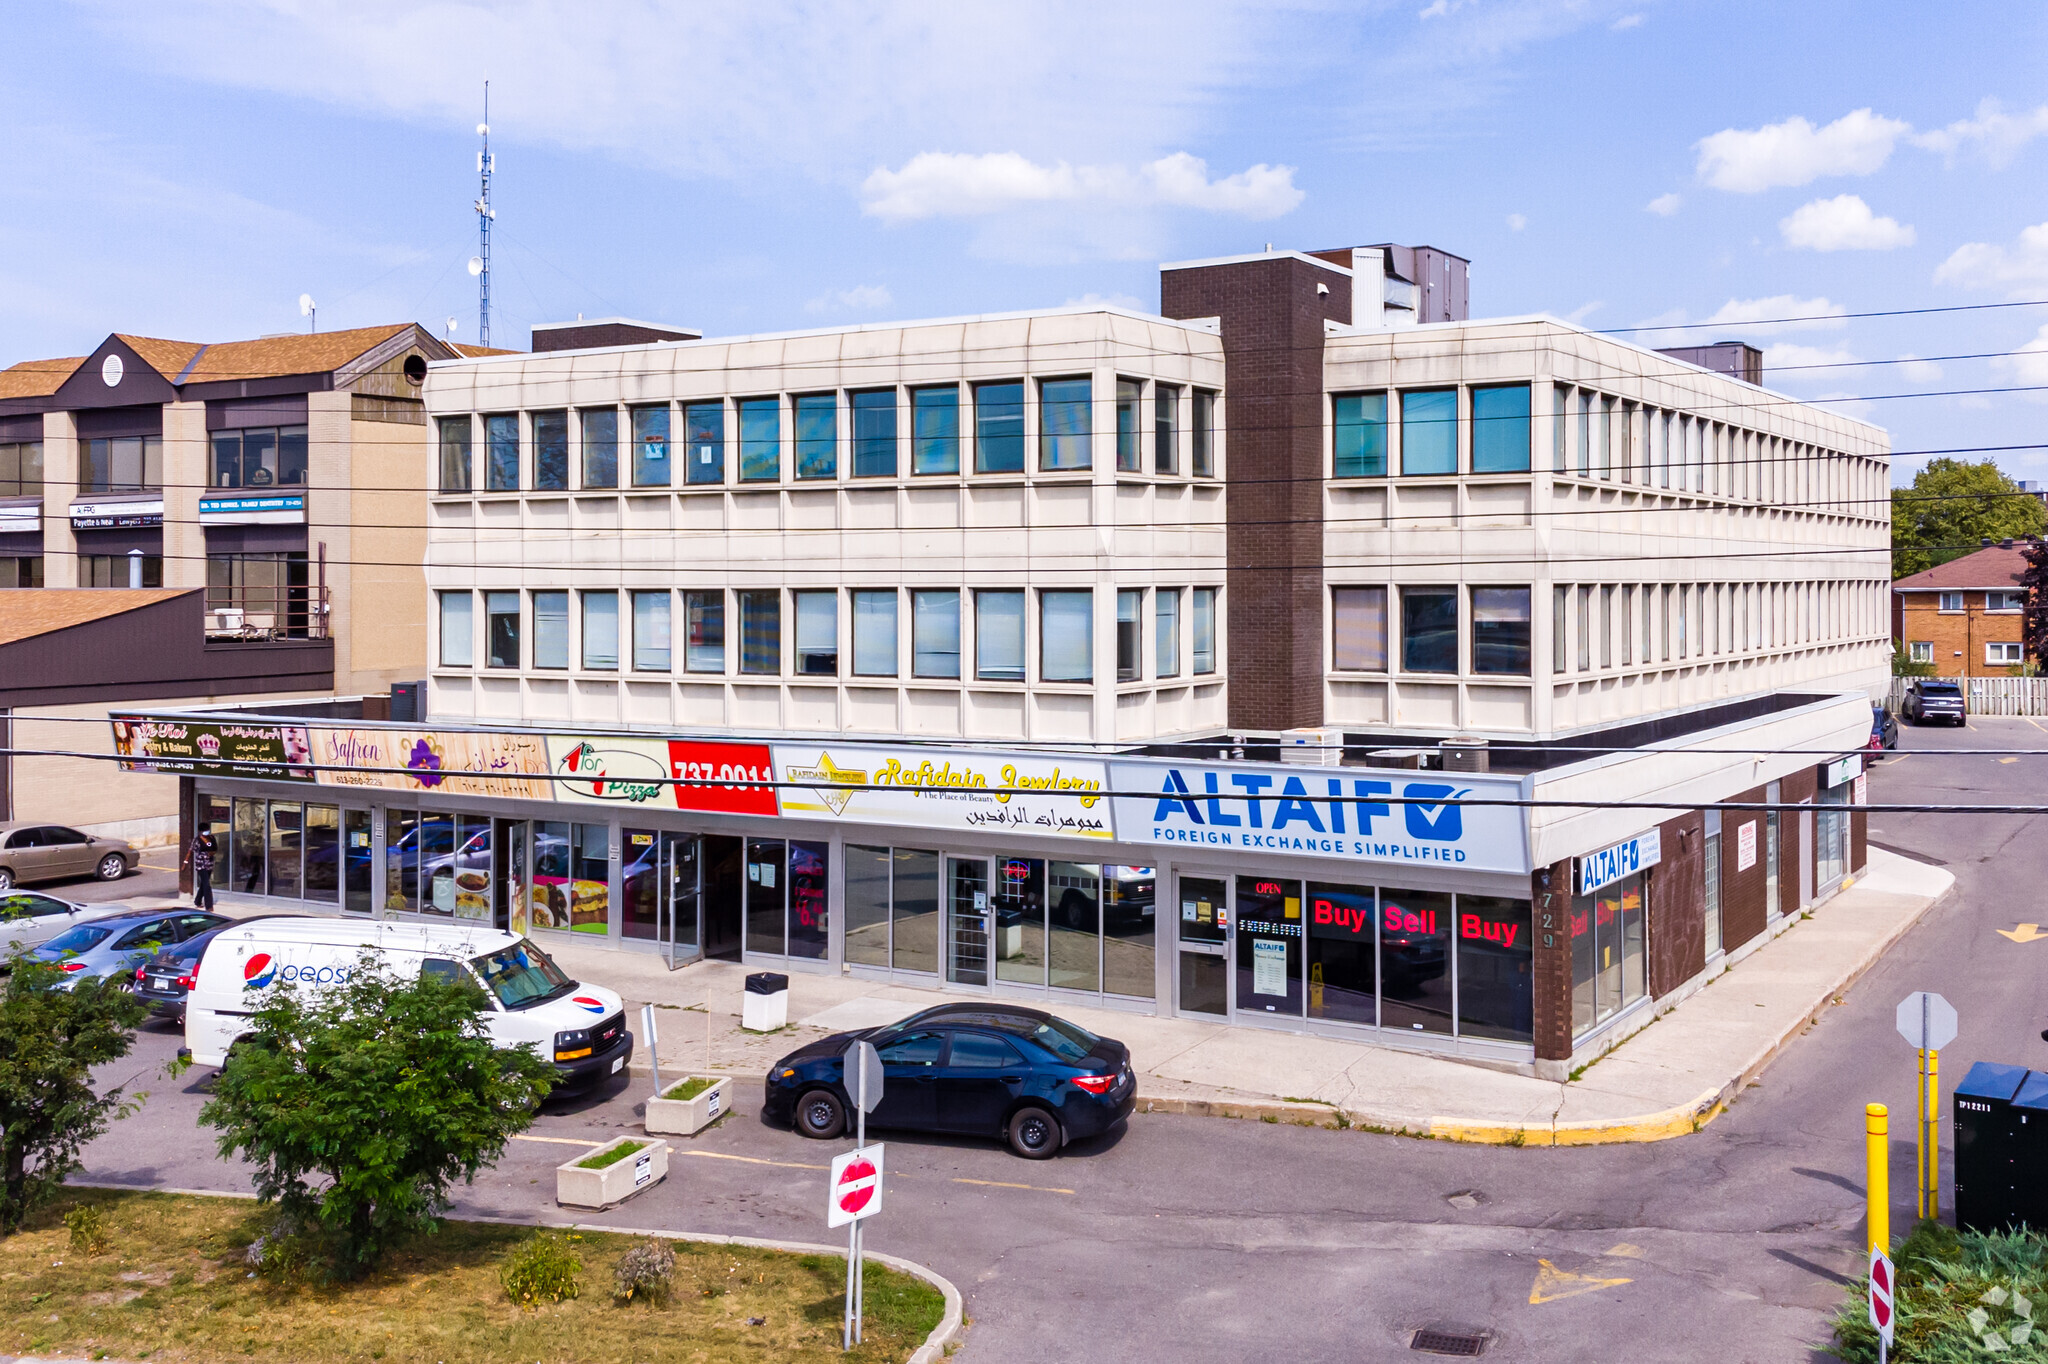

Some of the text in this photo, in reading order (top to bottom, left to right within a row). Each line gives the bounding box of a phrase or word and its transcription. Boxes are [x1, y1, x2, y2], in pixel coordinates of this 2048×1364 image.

[73, 518, 95, 529] Payette
[168, 742, 193, 756] Bakery
[325, 730, 383, 767] Saffron
[579, 744, 605, 771] for
[674, 761, 774, 793] 737-0011
[873, 758, 988, 798] Rafidain
[608, 780, 660, 802] Pizza
[939, 791, 959, 801] Place
[959, 793, 968, 801] of
[968, 793, 994, 805] Beauty
[1154, 769, 1392, 836] ALTAIF
[965, 805, 1104, 833] مجوهرات الرافدين
[1154, 827, 1466, 862] FOREIGN EXCHANGE SIMPLIFIED
[1583, 842, 1629, 892] ALTAIF
[1255, 881, 1282, 895] OPEN
[1314, 899, 1367, 934] Buy
[1384, 906, 1436, 935] Sell
[1461, 914, 1518, 948] Buy
[1254, 942, 1279, 951] ALTAIF
[281, 964, 353, 988] pepsi
